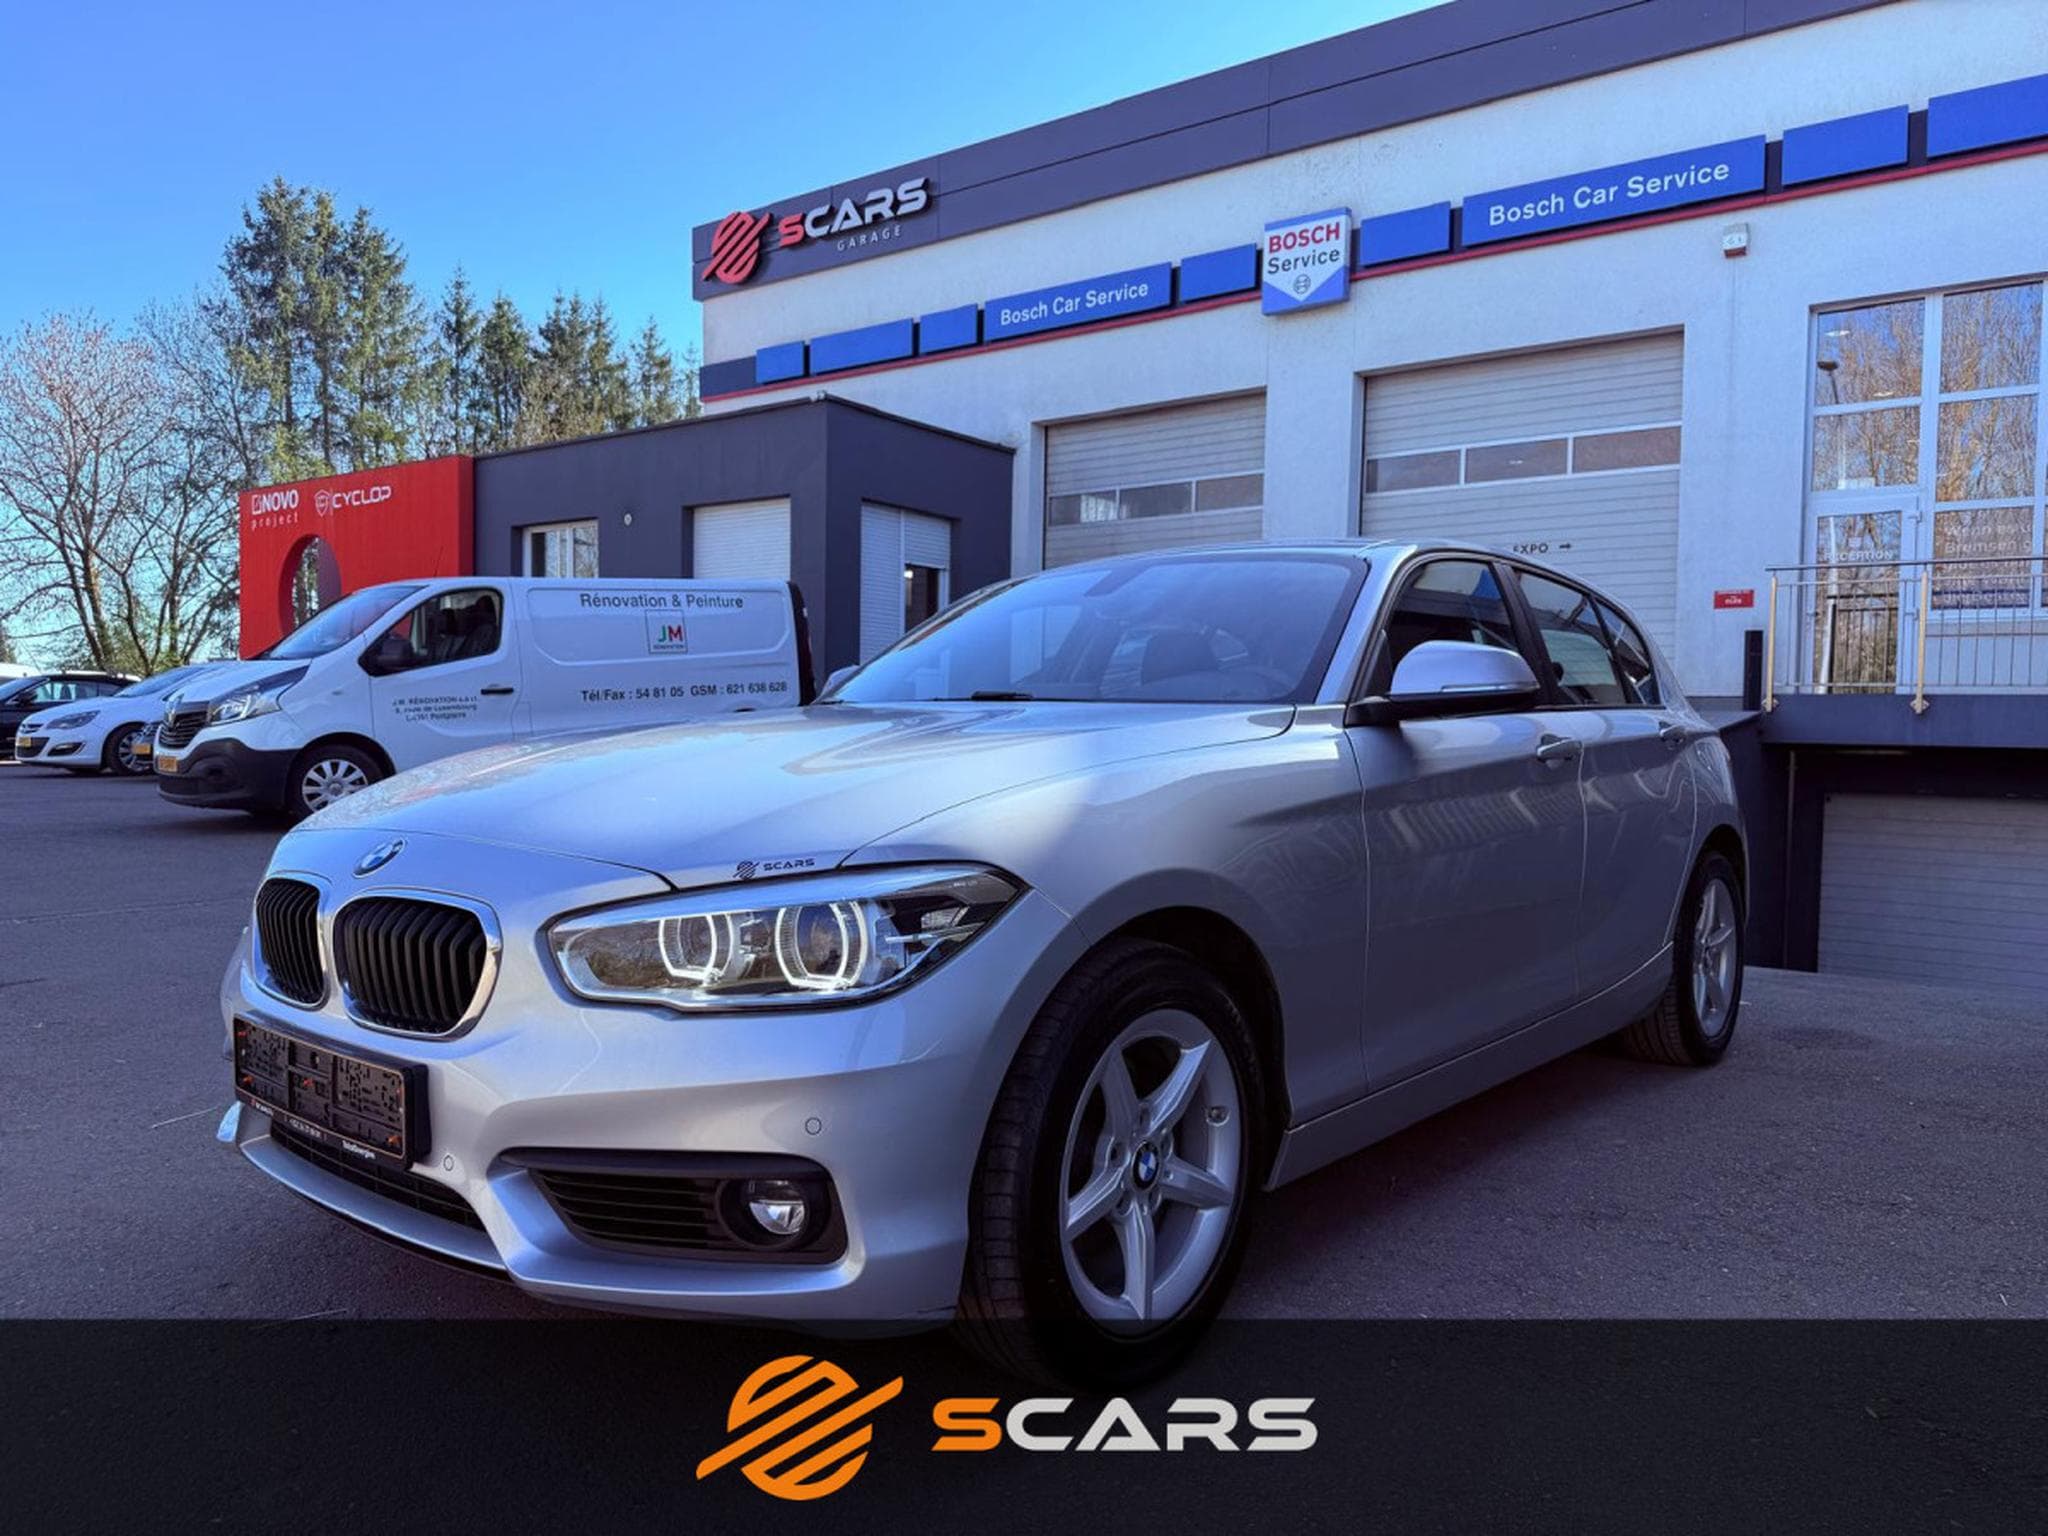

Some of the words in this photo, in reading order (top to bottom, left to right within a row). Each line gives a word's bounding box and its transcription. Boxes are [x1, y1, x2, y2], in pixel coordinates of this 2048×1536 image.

[1489, 193, 1565, 227] Bosch
[1573, 185, 1619, 209] Car
[1627, 163, 1730, 198] Service
[778, 177, 928, 247] SCARS
[837, 224, 902, 252] GARAGE
[1268, 221, 1340, 254] BOSCH
[1267, 248, 1340, 275] Service
[1000, 301, 1048, 326] Bosch
[1052, 296, 1081, 316] Car
[1085, 283, 1149, 309] Service
[331, 485, 392, 509] CYCLOP
[251, 510, 299, 532] project
[579, 593, 668, 609] Rénovation
[672, 593, 683, 608] &
[686, 593, 744, 609] Peinture
[657, 624, 684, 643] JM
[635, 687, 651, 700] 54
[653, 686, 667, 699] 81
[669, 685, 686, 698] 05
[690, 684, 718, 697] GSM
[763, 858, 816, 872] SCARS
